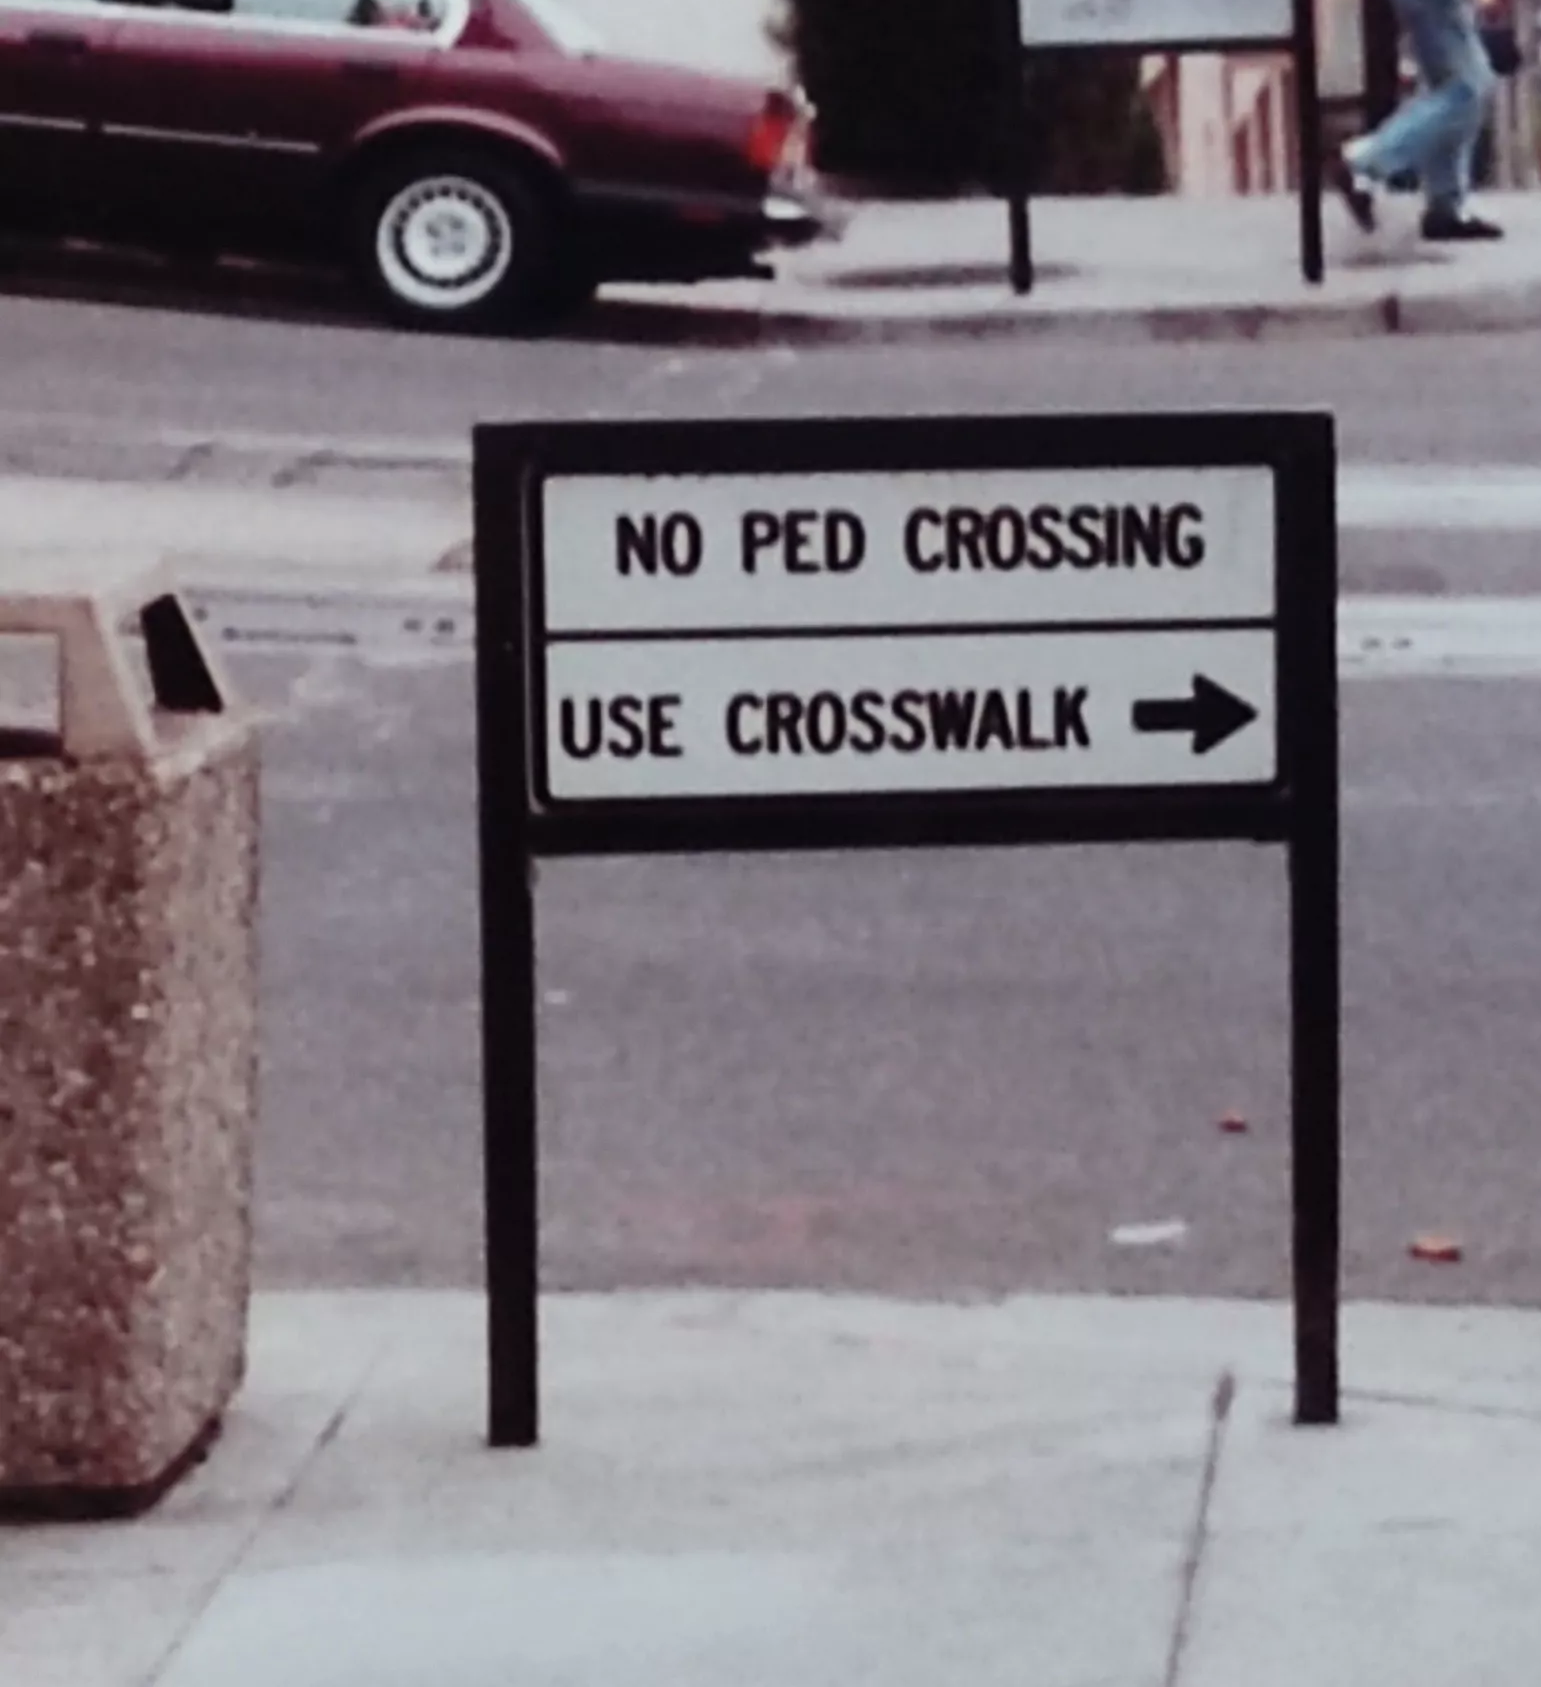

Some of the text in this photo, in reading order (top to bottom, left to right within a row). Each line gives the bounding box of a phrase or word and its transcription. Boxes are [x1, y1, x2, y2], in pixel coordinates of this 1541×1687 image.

[615, 502, 1206, 577] NO PED CROSSING
[560, 686, 1091, 760] USE CROSSWALK
